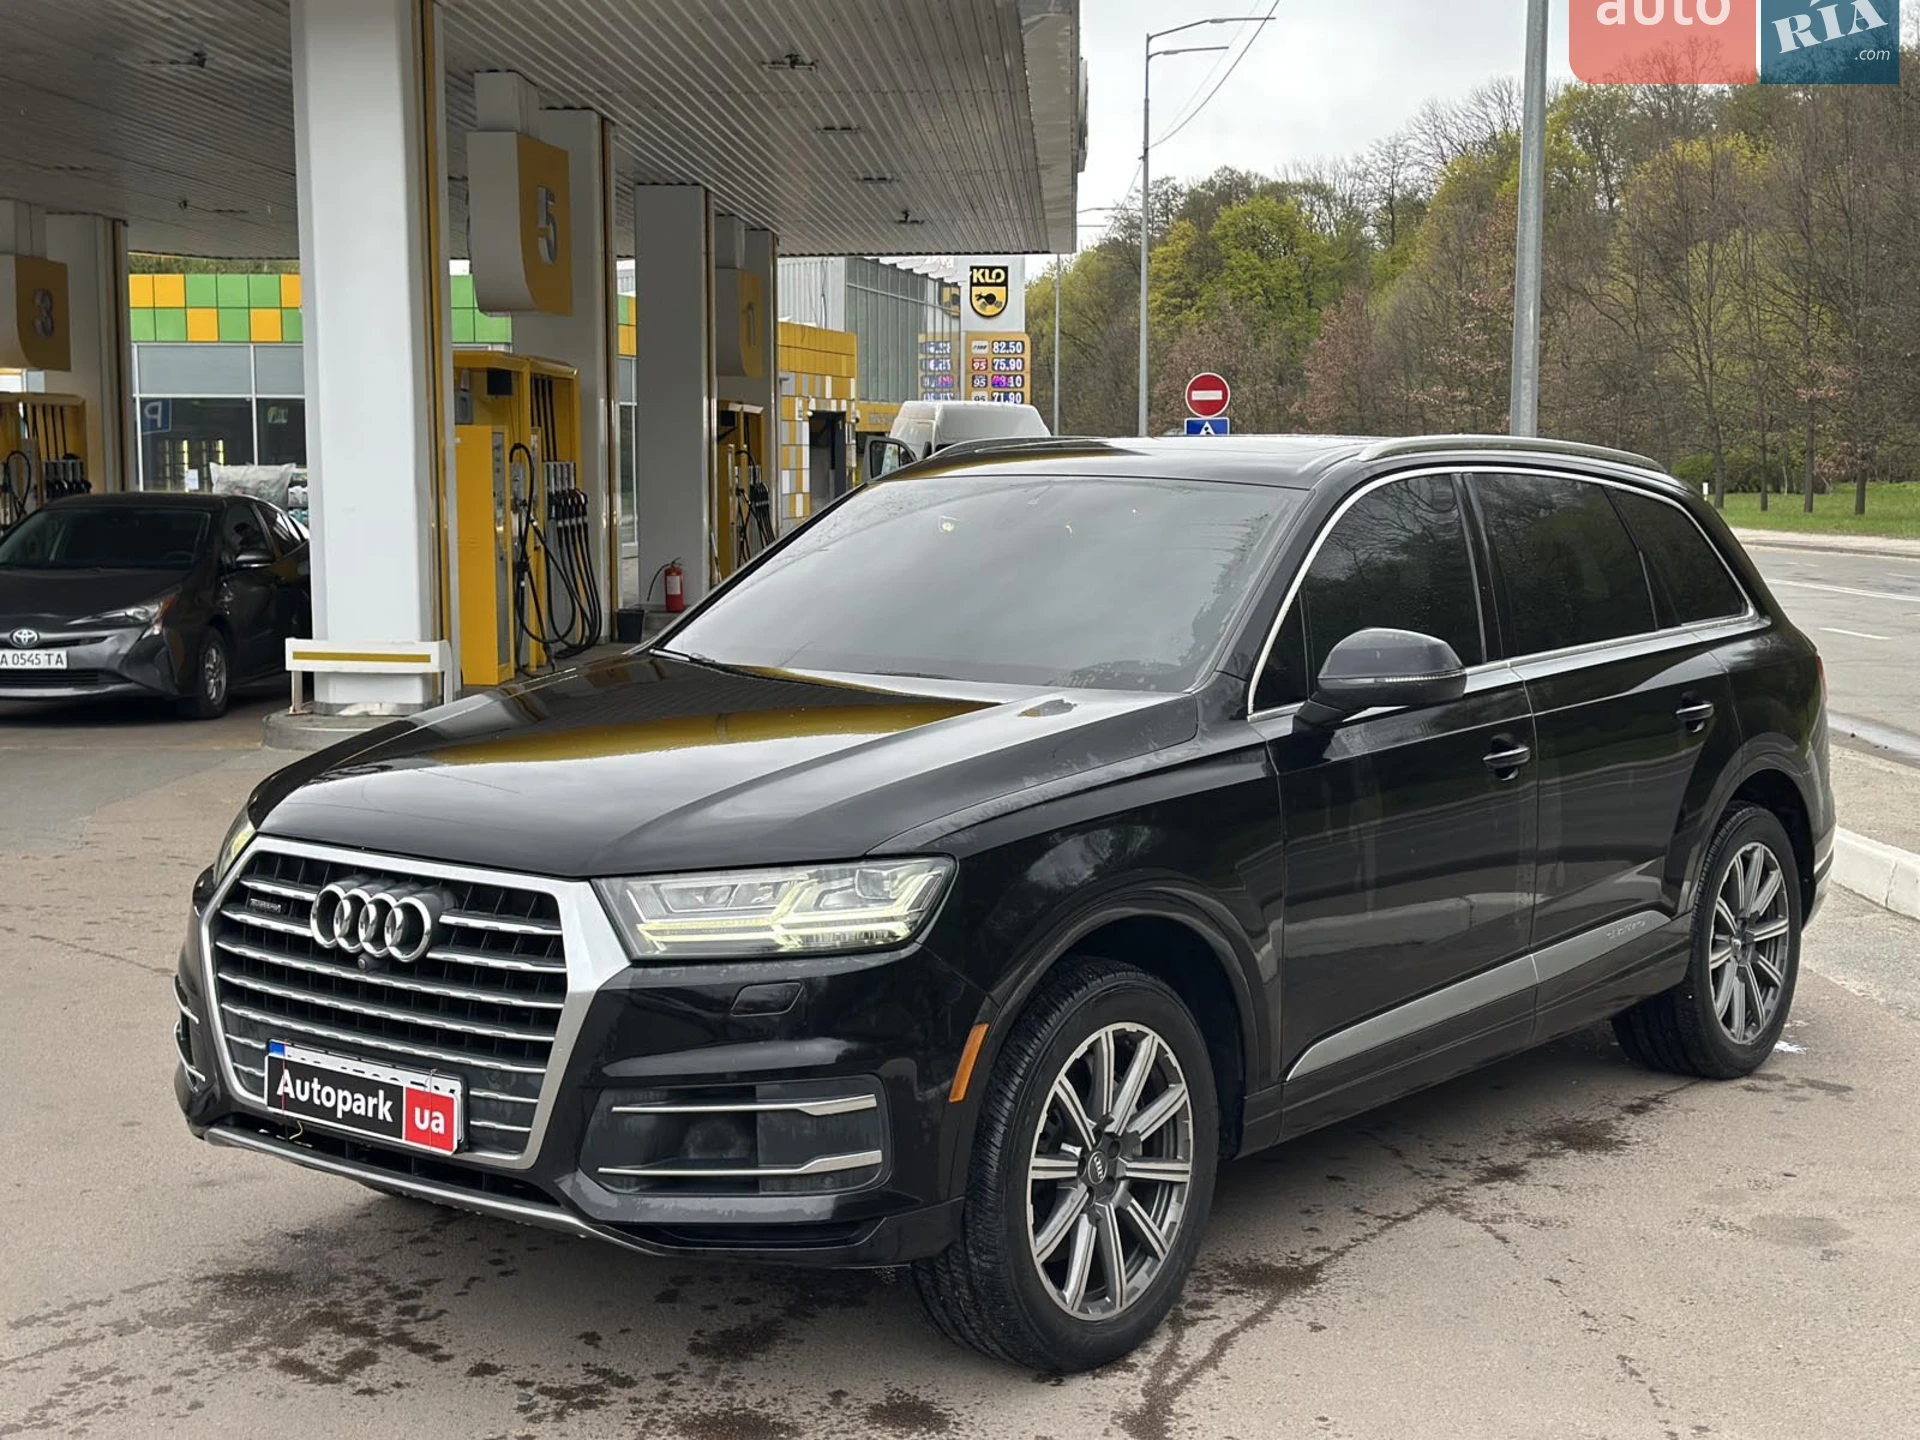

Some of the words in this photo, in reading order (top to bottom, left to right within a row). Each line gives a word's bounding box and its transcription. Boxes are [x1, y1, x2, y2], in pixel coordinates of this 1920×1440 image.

[537, 185, 557, 265] 5
[972, 268, 1005, 284] KLO
[32, 288, 54, 338] 3
[742, 302, 757, 347] 1
[993, 341, 1023, 353] 82.50
[973, 361, 986, 371] 95
[993, 358, 1023, 371] 75.90
[973, 378, 986, 387] 95
[992, 392, 1022, 404] 71.90
[12, 653, 41, 666] 0545
[44, 653, 64, 666] TA
[277, 1069, 393, 1122] Autopark
[414, 1105, 445, 1135] ua
